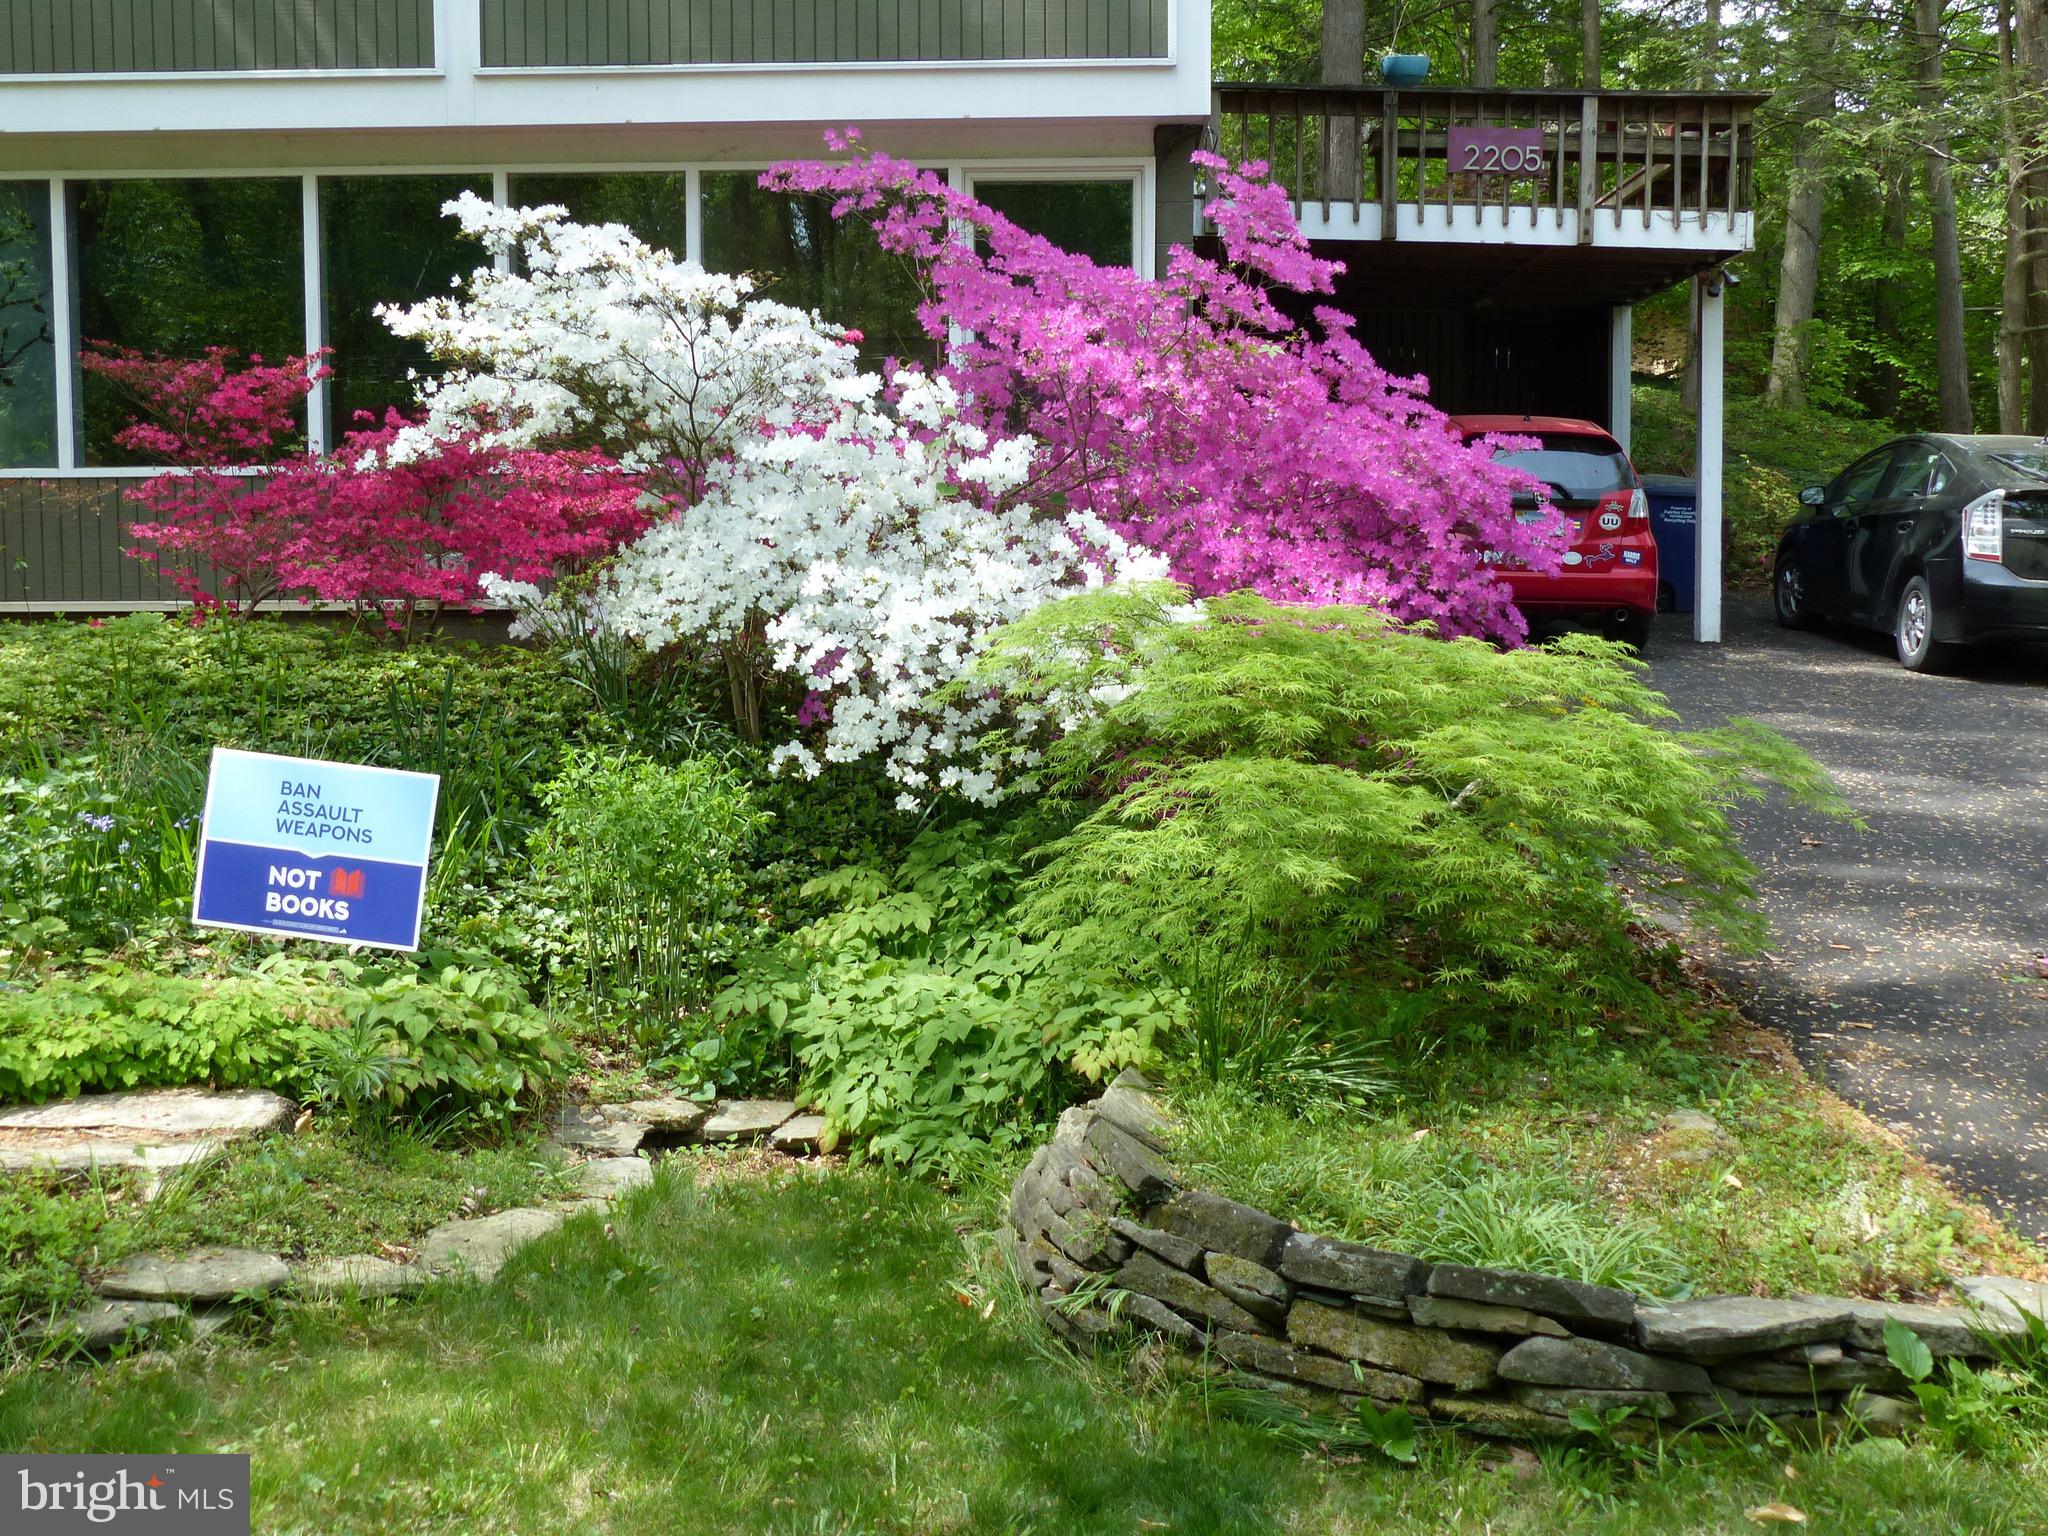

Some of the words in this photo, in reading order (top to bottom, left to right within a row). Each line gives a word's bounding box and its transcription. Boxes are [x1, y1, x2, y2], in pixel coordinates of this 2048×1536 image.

[1463, 144, 1542, 172] 2205
[1602, 517, 1619, 526] UU
[280, 780, 321, 799] BAN
[277, 800, 363, 823] ASSAULT
[276, 818, 373, 844] WEAPONS
[268, 865, 322, 890] NOT
[265, 892, 350, 921] BOOKS
